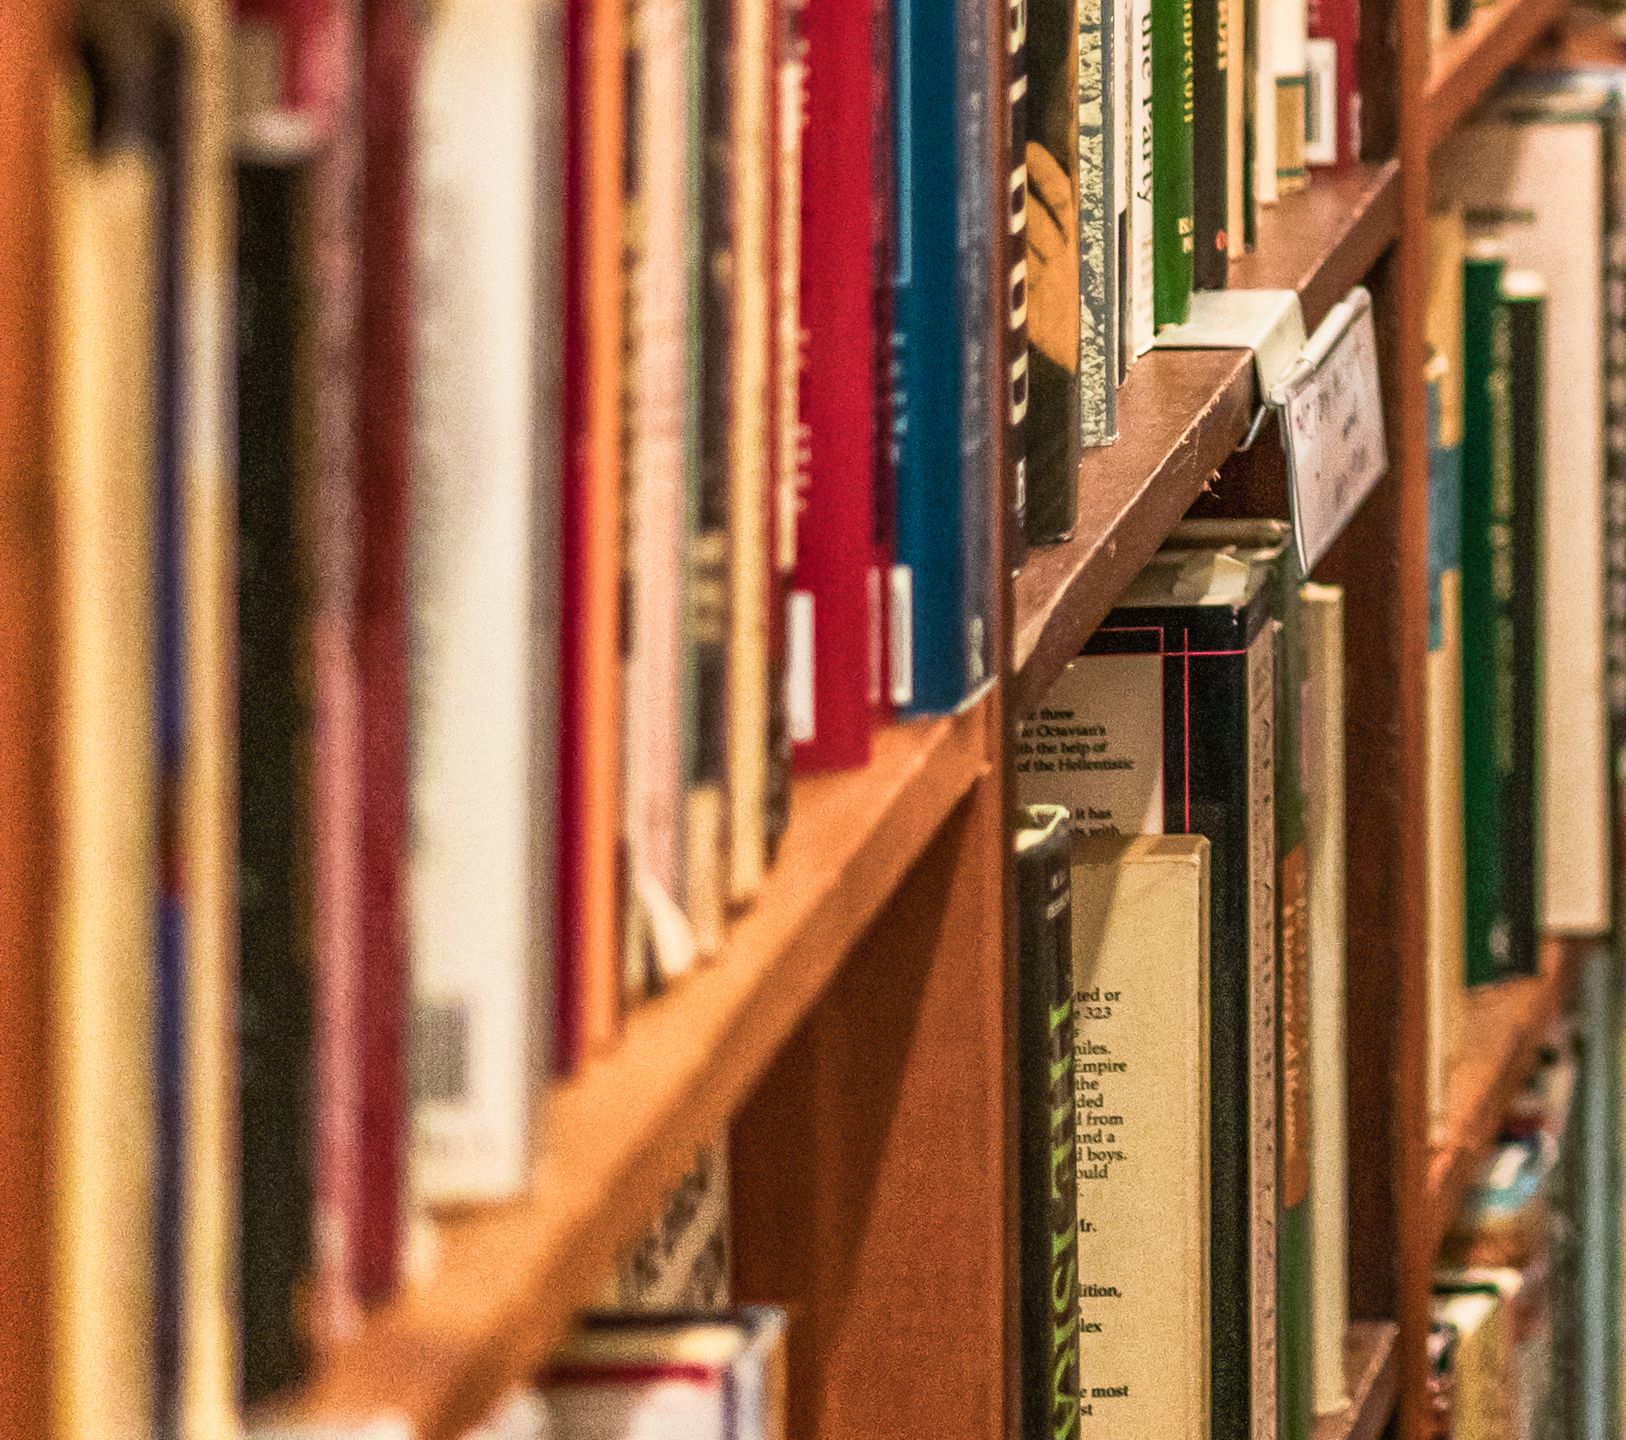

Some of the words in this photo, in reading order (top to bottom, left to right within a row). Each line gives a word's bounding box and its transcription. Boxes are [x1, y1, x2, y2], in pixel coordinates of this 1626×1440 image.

[1036, 742, 1057, 754] the
[1060, 741, 1091, 758] help
[1092, 740, 1108, 753] of
[1033, 760, 1055, 771] the
[1088, 807, 1112, 819] has
[1105, 992, 1121, 1002] or
[1084, 1007, 1112, 1019] 323
[1086, 1111, 1124, 1126] from
[1087, 1147, 1127, 1165] boys.
[1091, 1384, 1129, 1399] most
